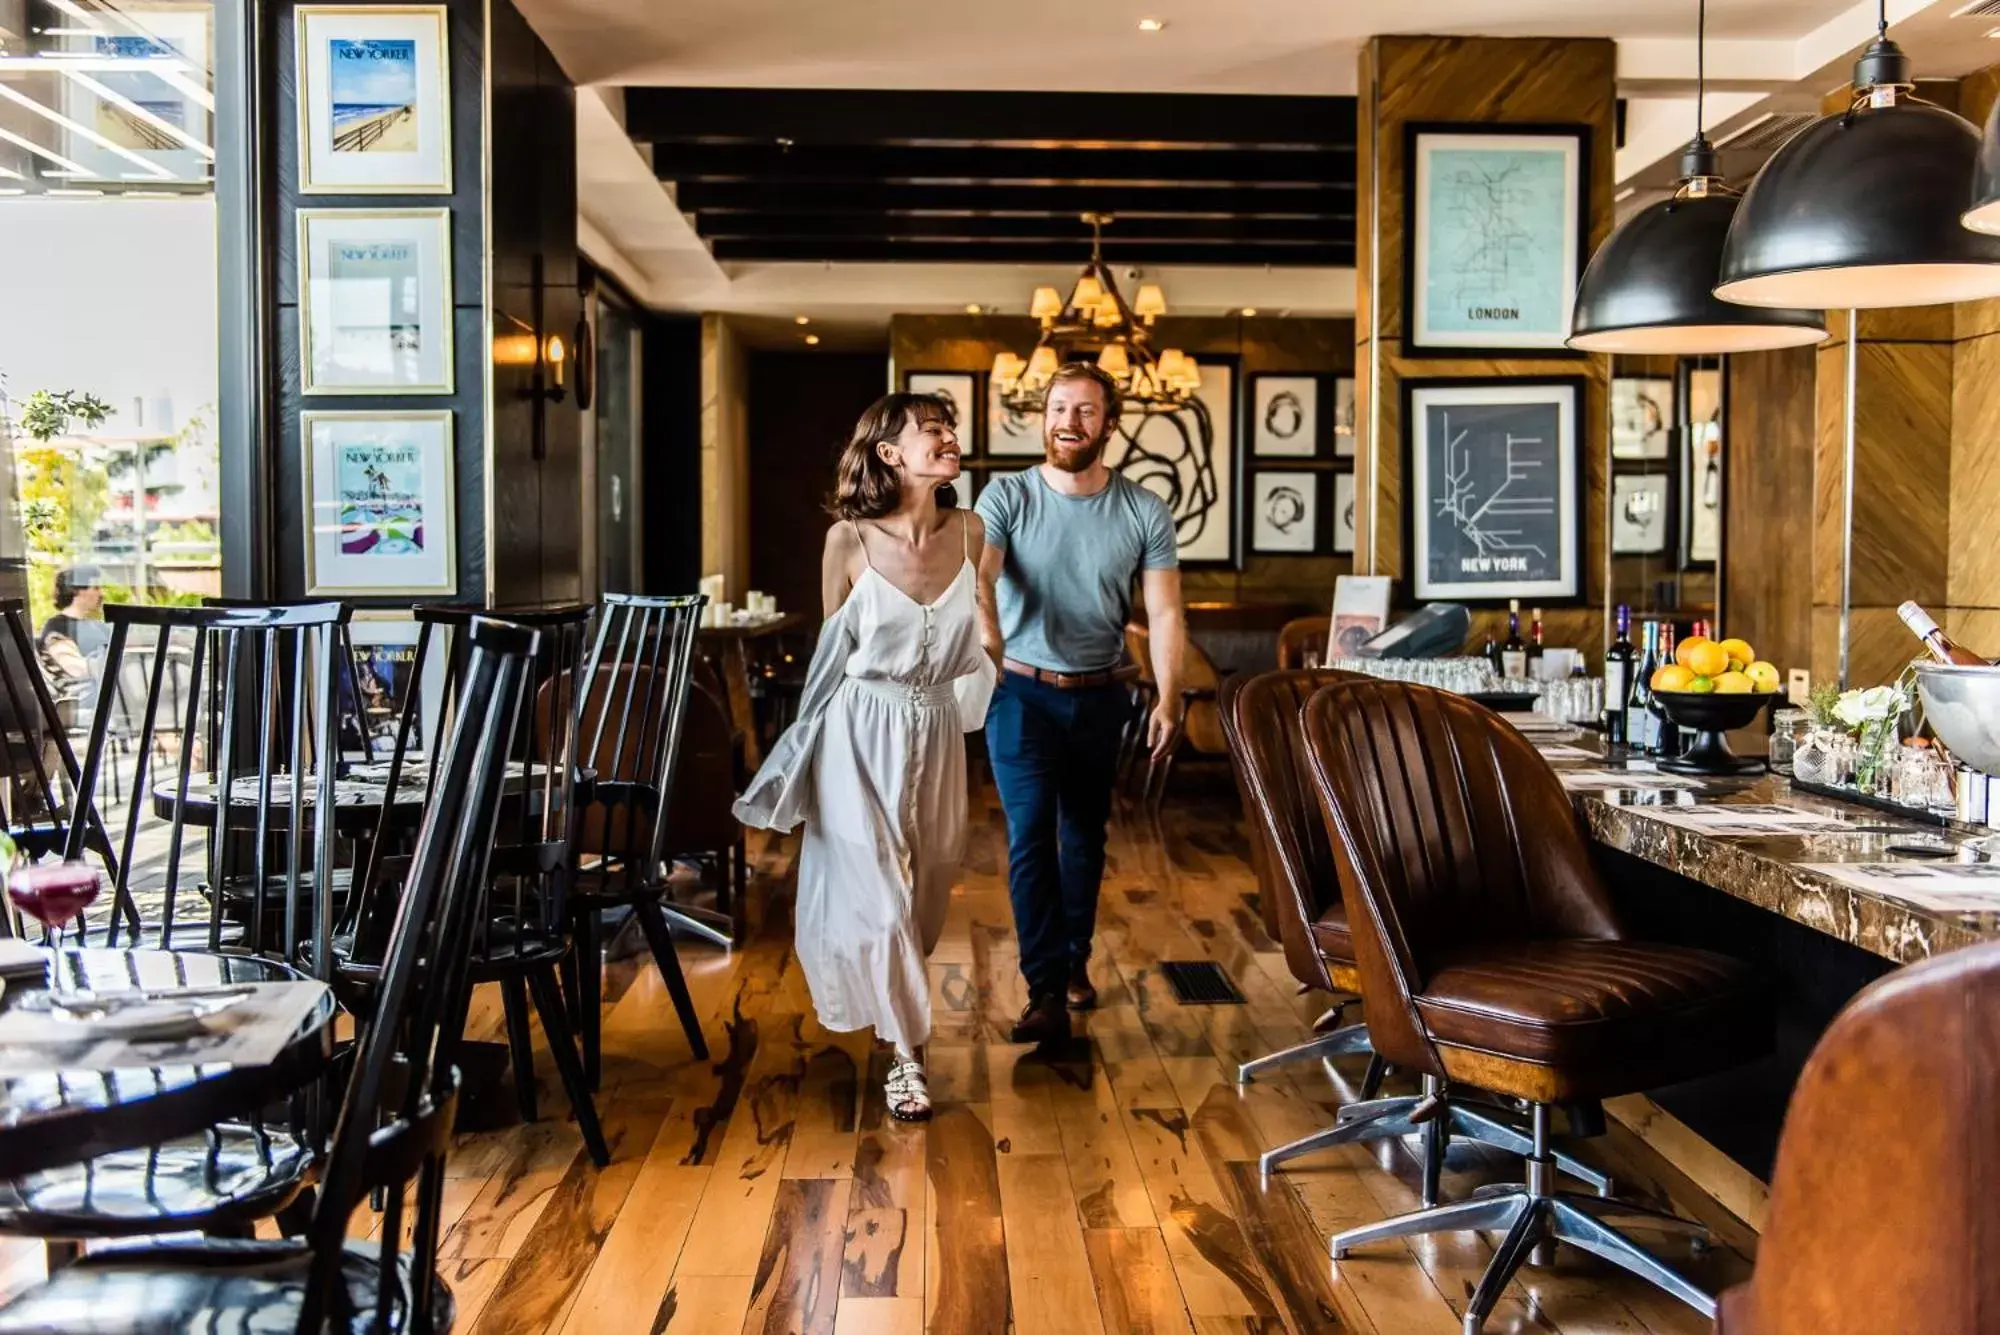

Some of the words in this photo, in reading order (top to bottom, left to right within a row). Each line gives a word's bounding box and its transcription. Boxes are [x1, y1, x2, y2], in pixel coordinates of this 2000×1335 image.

[339, 48, 366, 60] NEW
[367, 48, 409, 60] YORKER
[1467, 307, 1519, 320] LONDON
[346, 451, 371, 463] NEW
[1461, 557, 1490, 573] NEW
[1492, 556, 1528, 573] YORK
[354, 649, 371, 661] EW
